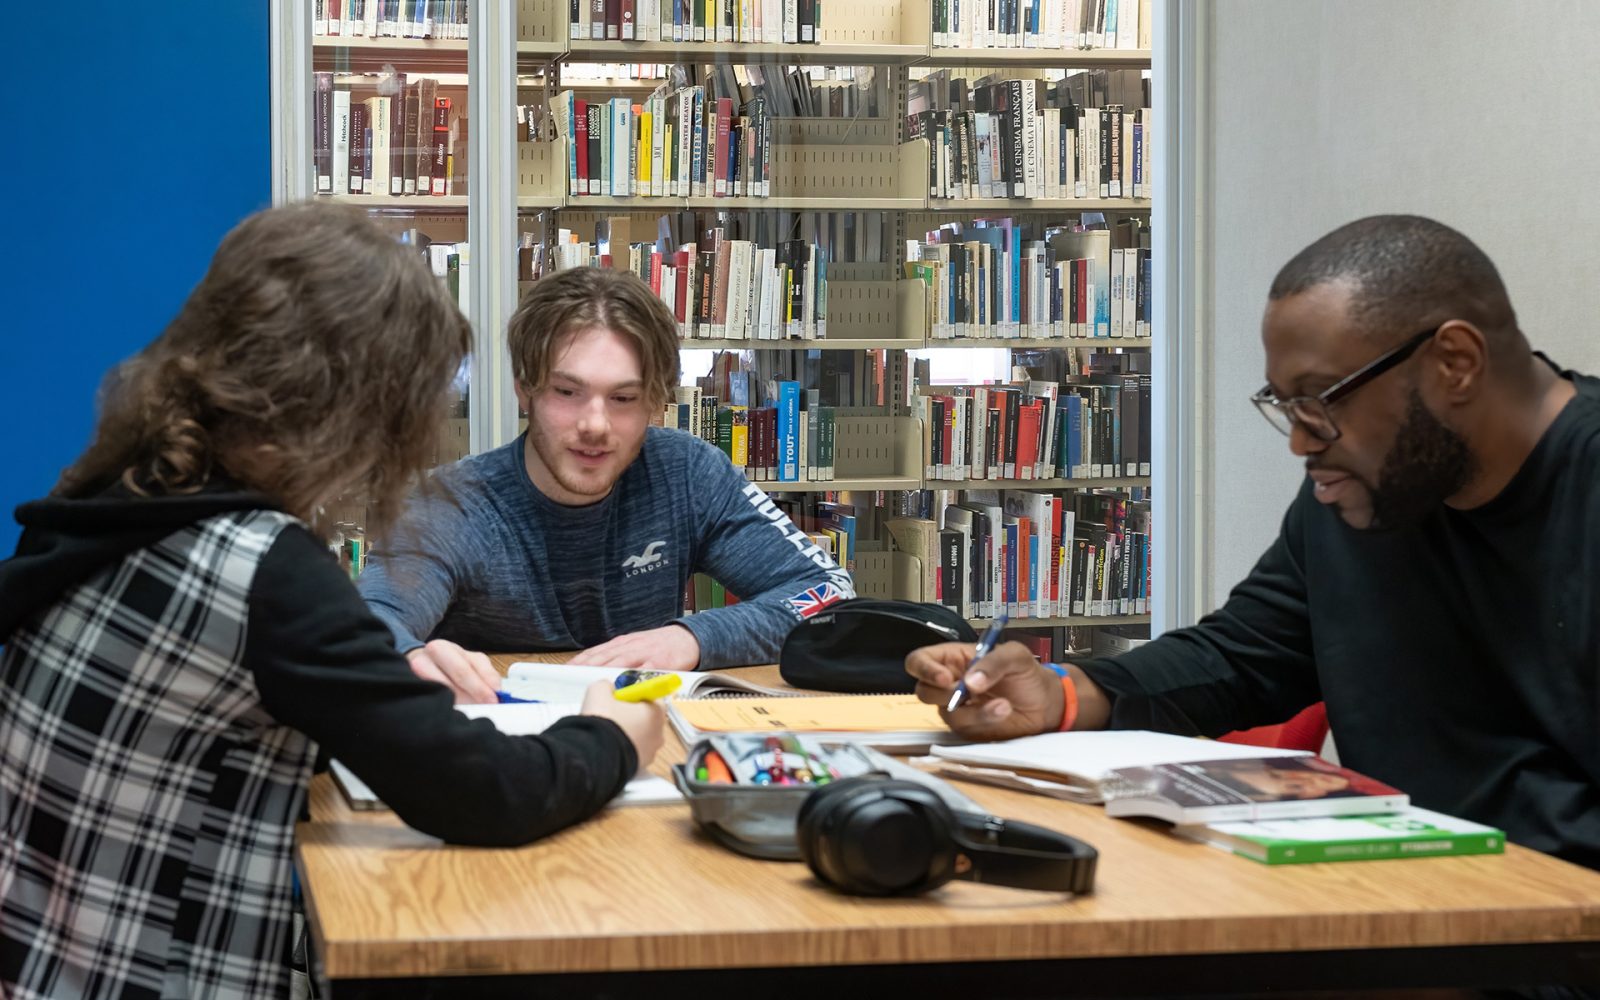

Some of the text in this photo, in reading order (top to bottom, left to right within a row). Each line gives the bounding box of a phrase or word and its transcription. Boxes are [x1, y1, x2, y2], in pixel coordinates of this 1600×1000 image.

[1012, 82, 1022, 178] LE CINEMA FRANÇAIS
[1026, 82, 1035, 178] LE CINEMA FRANÇAIS
[436, 143, 444, 166] Huston
[787, 434, 795, 463] TOUT
[950, 545, 958, 567] CARTOONS
[1051, 534, 1062, 567] DISNEY
[625, 559, 669, 578] LONDON
[1097, 548, 1105, 591] science-fiction
[1122, 550, 1131, 587] EXPÉRIMENTAL
